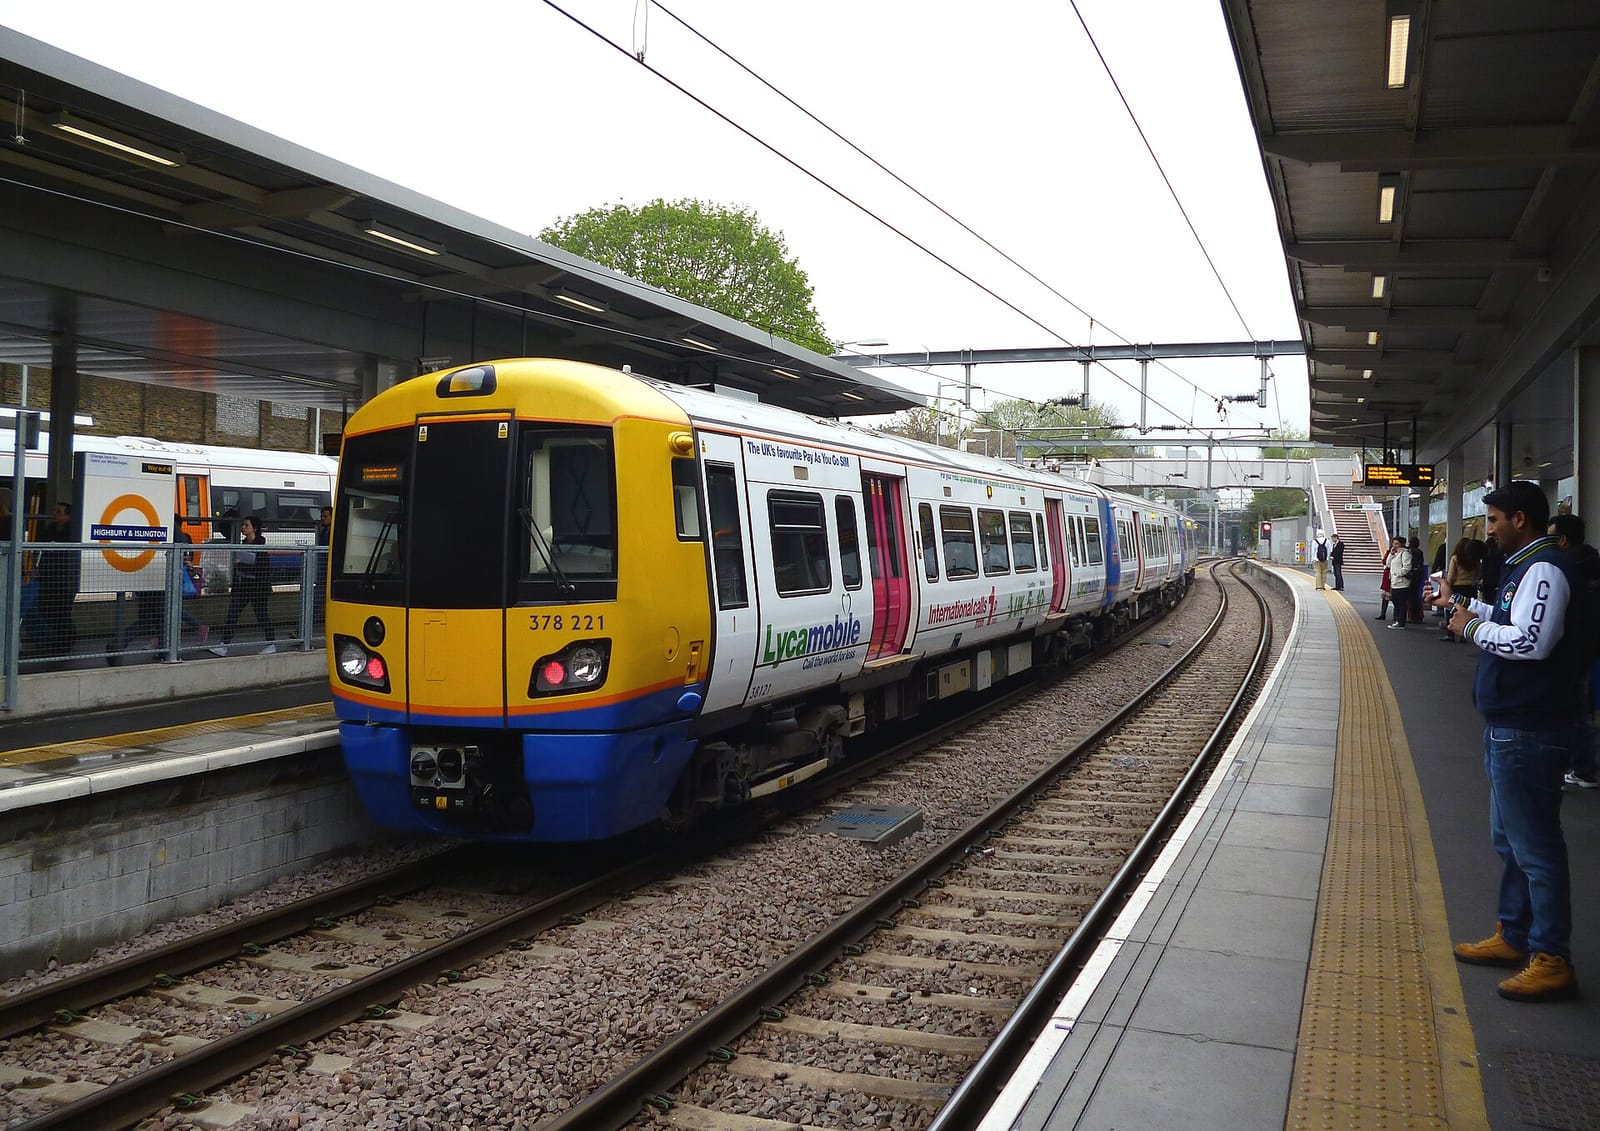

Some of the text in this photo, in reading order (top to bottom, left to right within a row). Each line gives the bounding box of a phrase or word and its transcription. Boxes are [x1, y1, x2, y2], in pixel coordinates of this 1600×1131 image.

[747, 441, 849, 467] The UK's favourite Pay As You Go SIM
[93, 529, 127, 537] HIGHBURY
[134, 530, 167, 538] ISLINGTON
[928, 598, 973, 624] International
[973, 596, 987, 615] calls
[1480, 580, 1550, 654] COSMOS
[529, 615, 604, 631] 378 221
[763, 612, 861, 669] Lycamobile
[802, 657, 814, 670] Call
[814, 655, 823, 667] the
[823, 652, 839, 666] world
[846, 649, 856, 659] less
[749, 683, 772, 699] 38121
